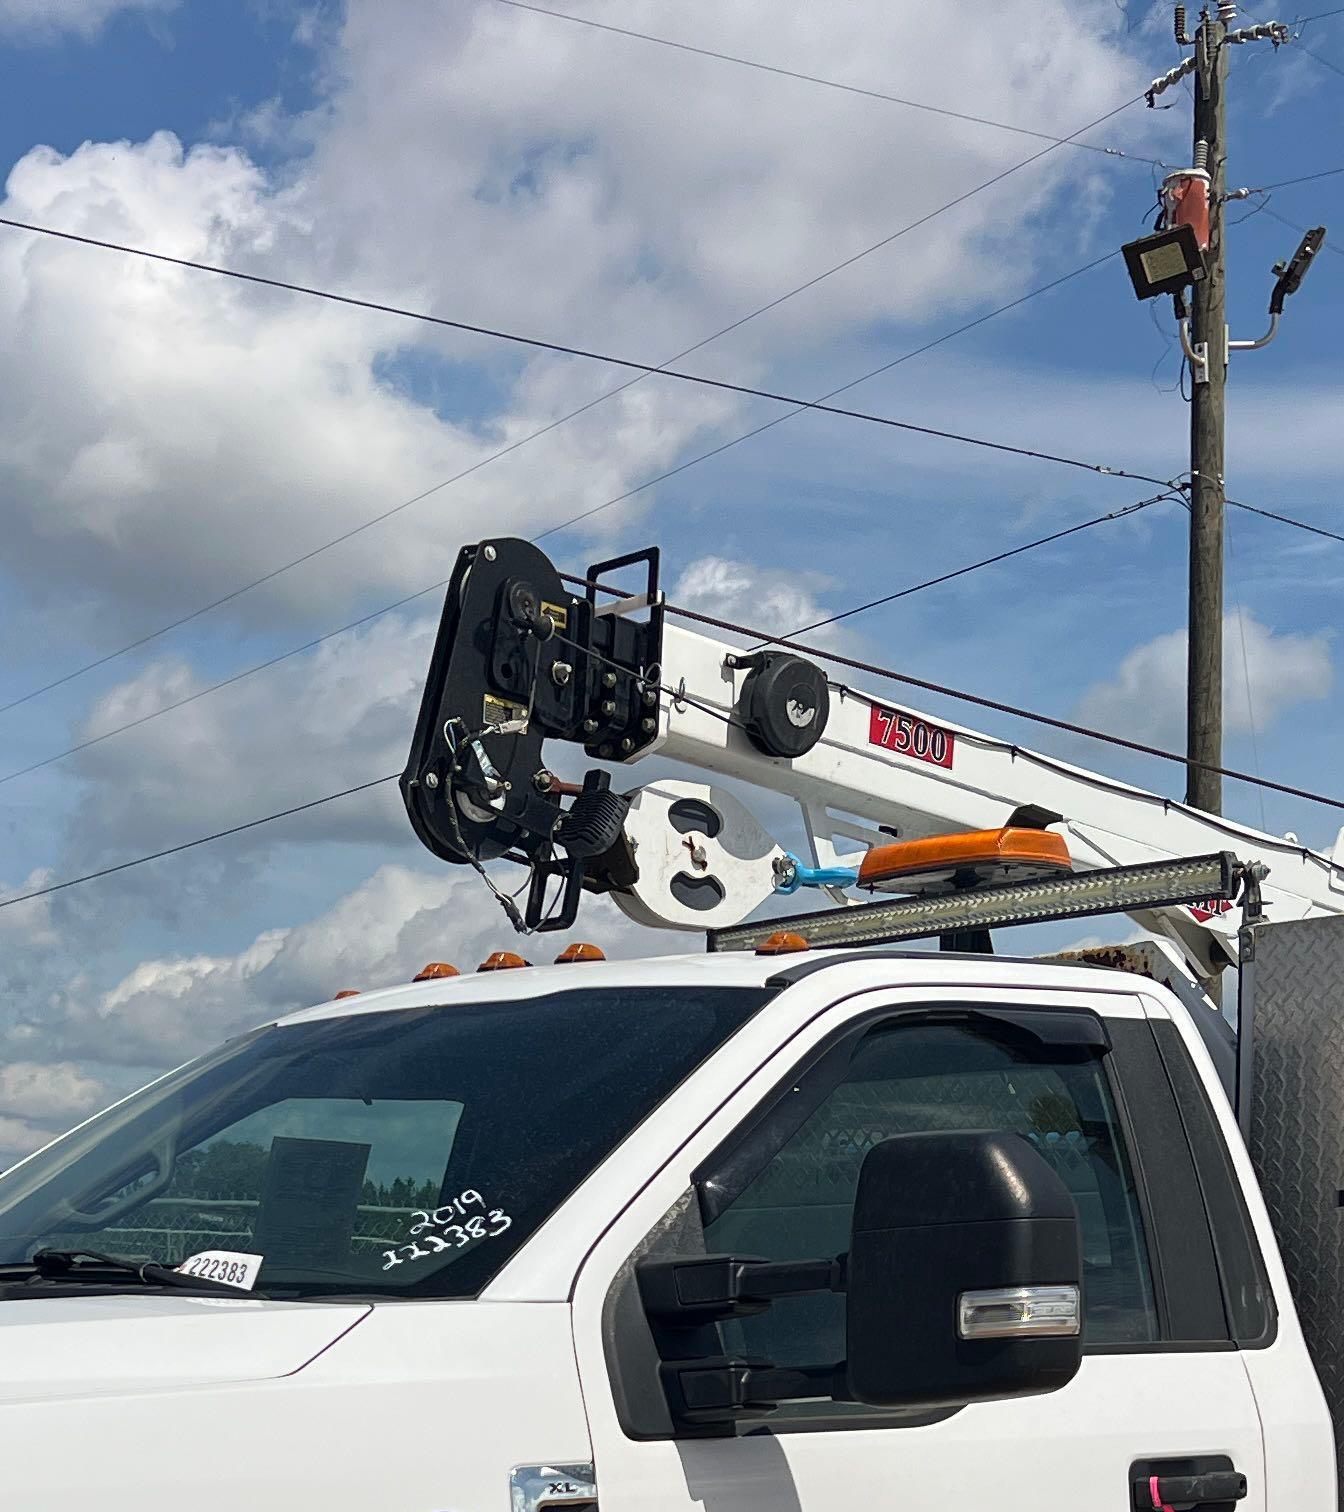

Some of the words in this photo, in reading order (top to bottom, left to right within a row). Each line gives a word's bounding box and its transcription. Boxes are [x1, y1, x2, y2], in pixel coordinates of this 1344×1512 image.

[876, 708, 946, 763] 7500
[409, 1189, 486, 1235] 2019
[381, 1208, 513, 1271] 222383
[188, 1256, 249, 1284] 222383
[549, 1482, 576, 1494] XL
